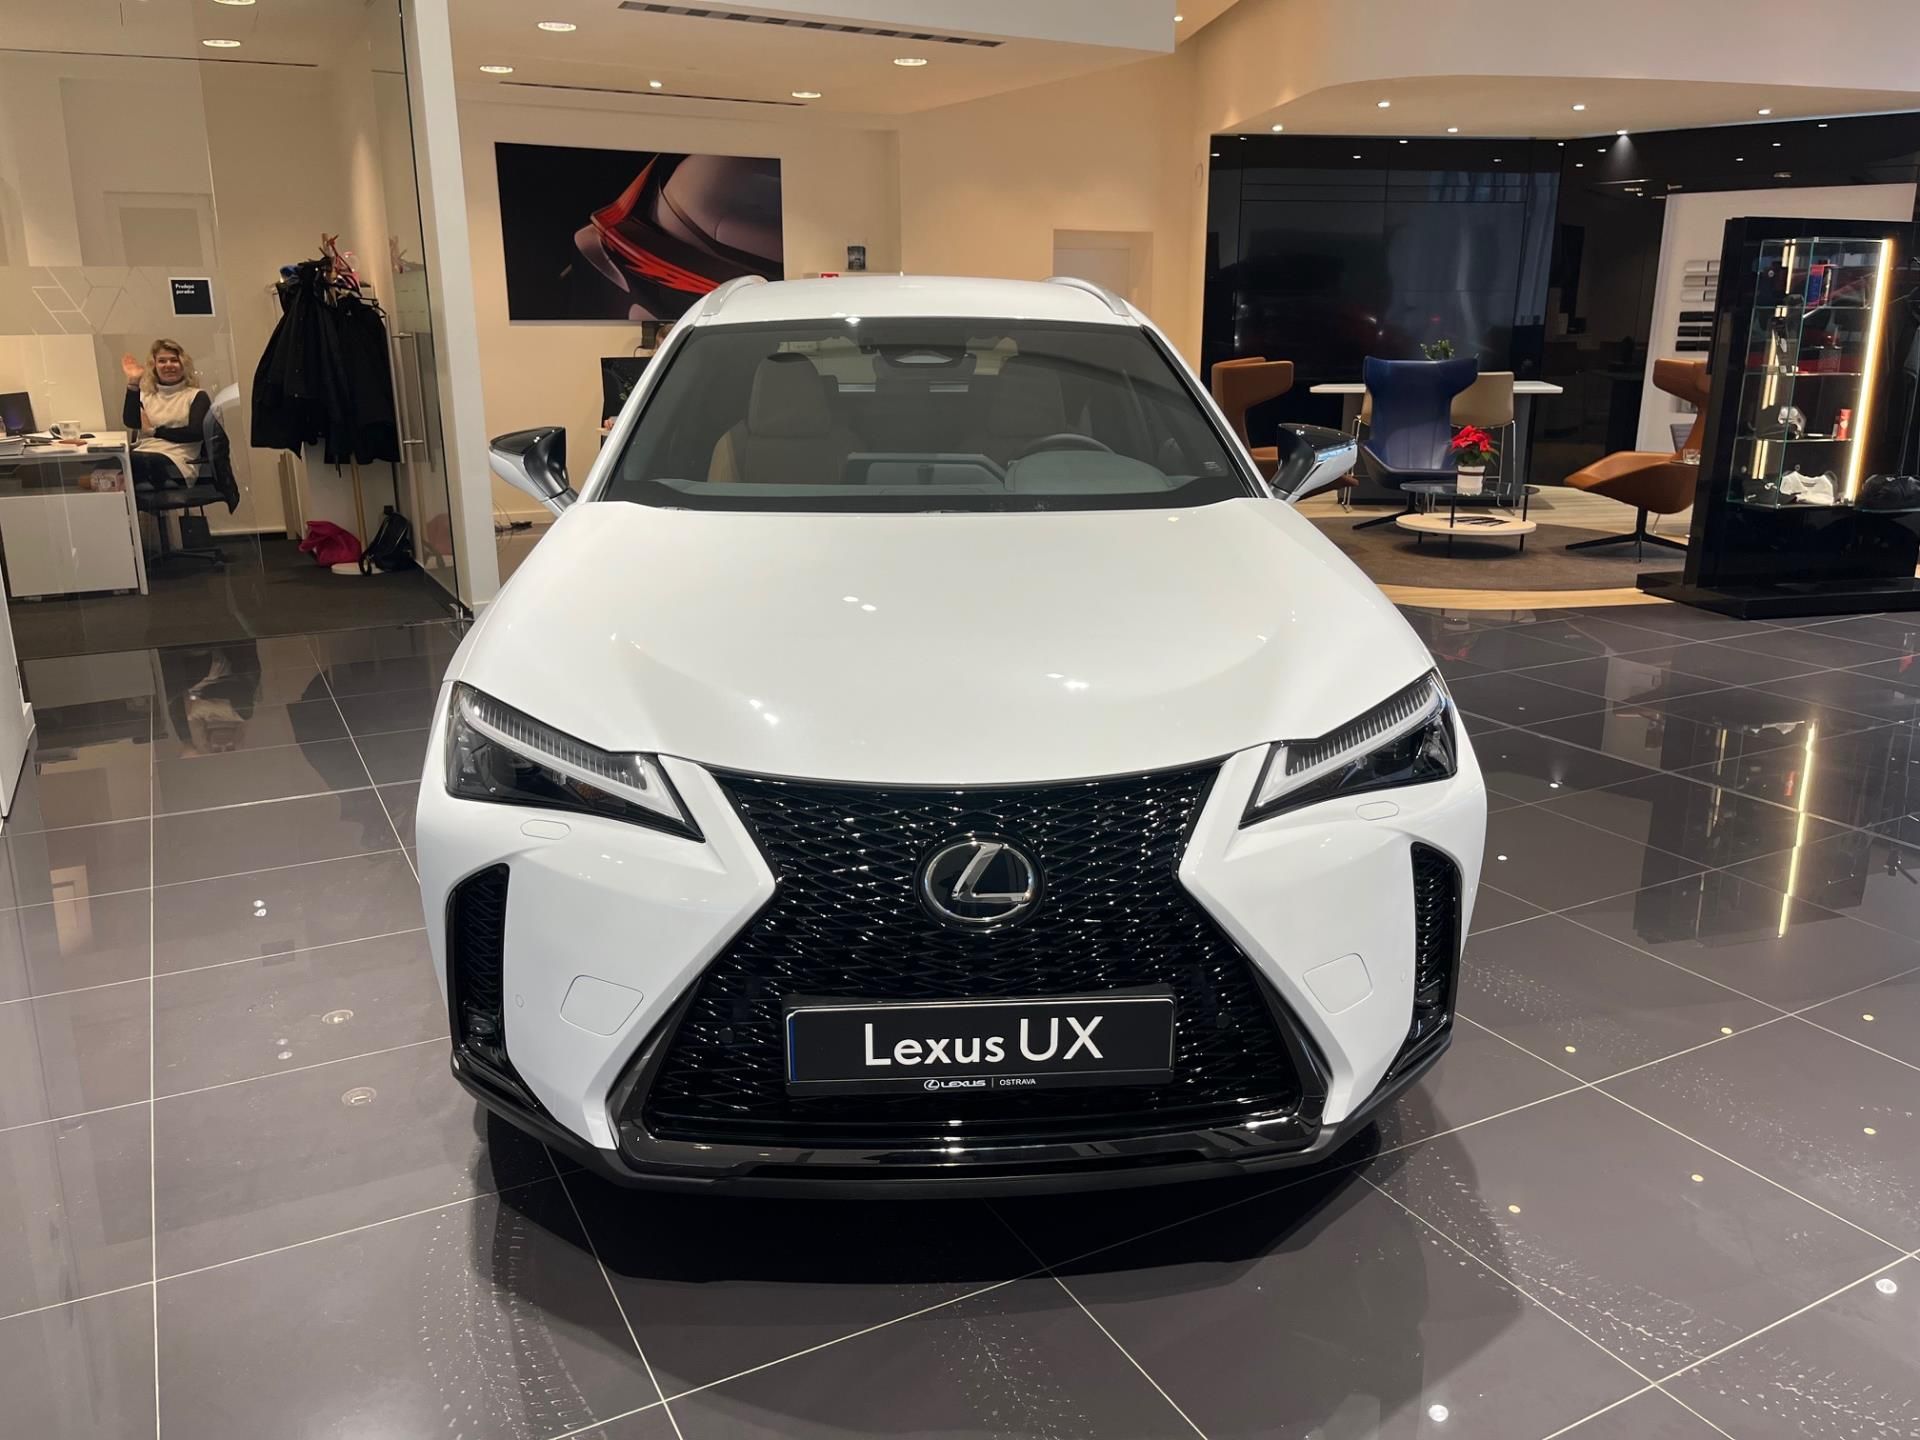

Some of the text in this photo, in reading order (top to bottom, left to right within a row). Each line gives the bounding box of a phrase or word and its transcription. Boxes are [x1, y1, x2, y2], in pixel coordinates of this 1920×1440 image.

[864, 1015, 1104, 1066] Lexus UX
[941, 1078, 1036, 1088] LEXUS OSTRAVA
